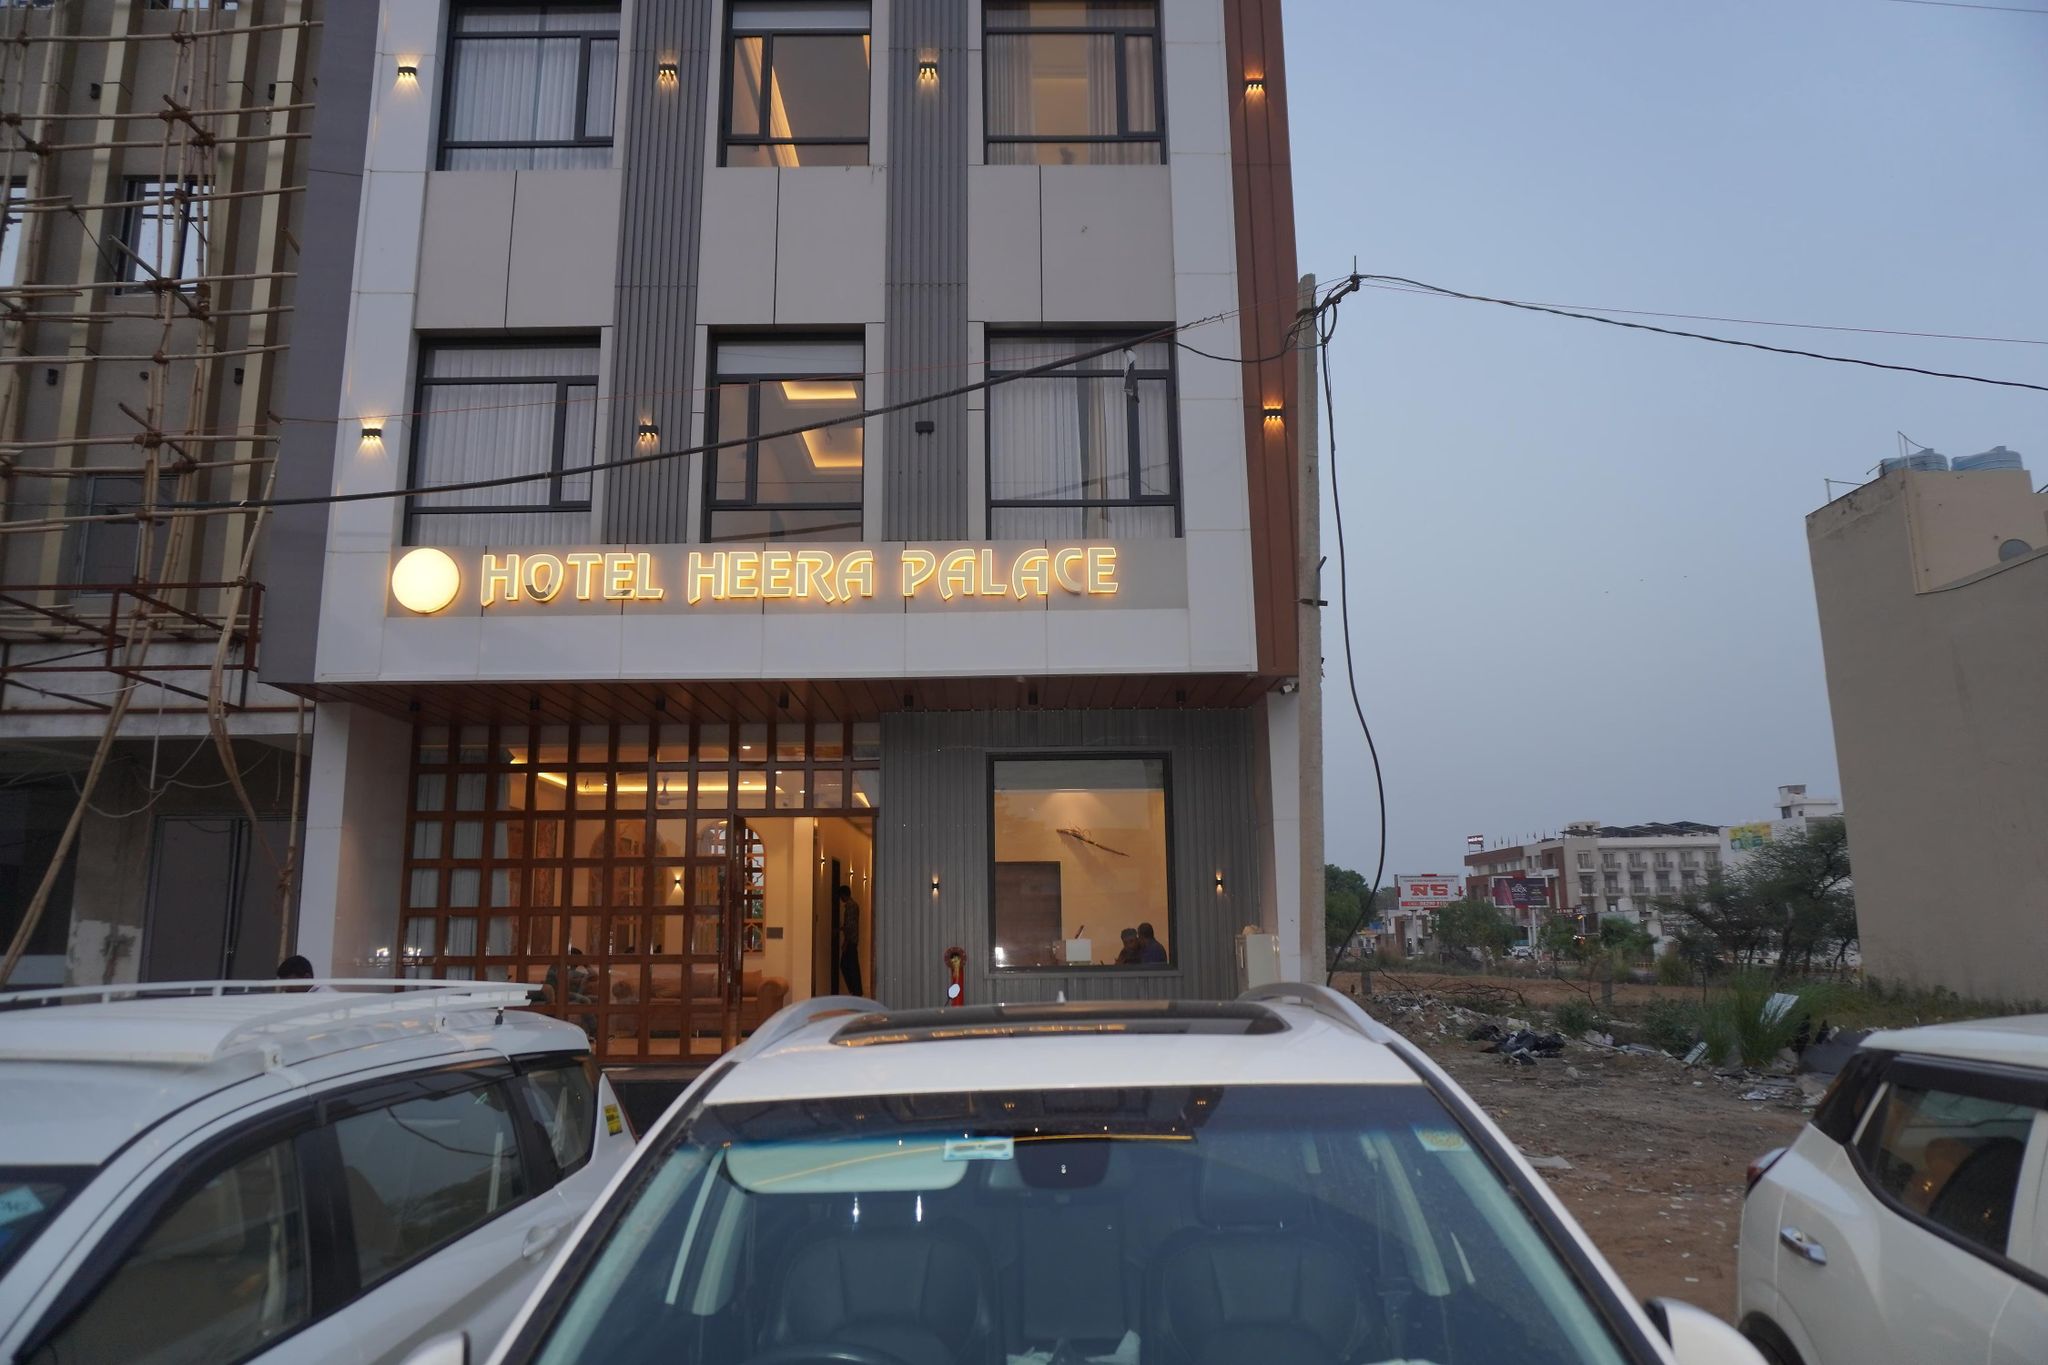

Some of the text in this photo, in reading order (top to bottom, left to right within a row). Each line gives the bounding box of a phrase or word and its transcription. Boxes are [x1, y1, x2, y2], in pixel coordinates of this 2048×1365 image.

[481, 547, 1119, 607] HOTEL HEERA PALACE
